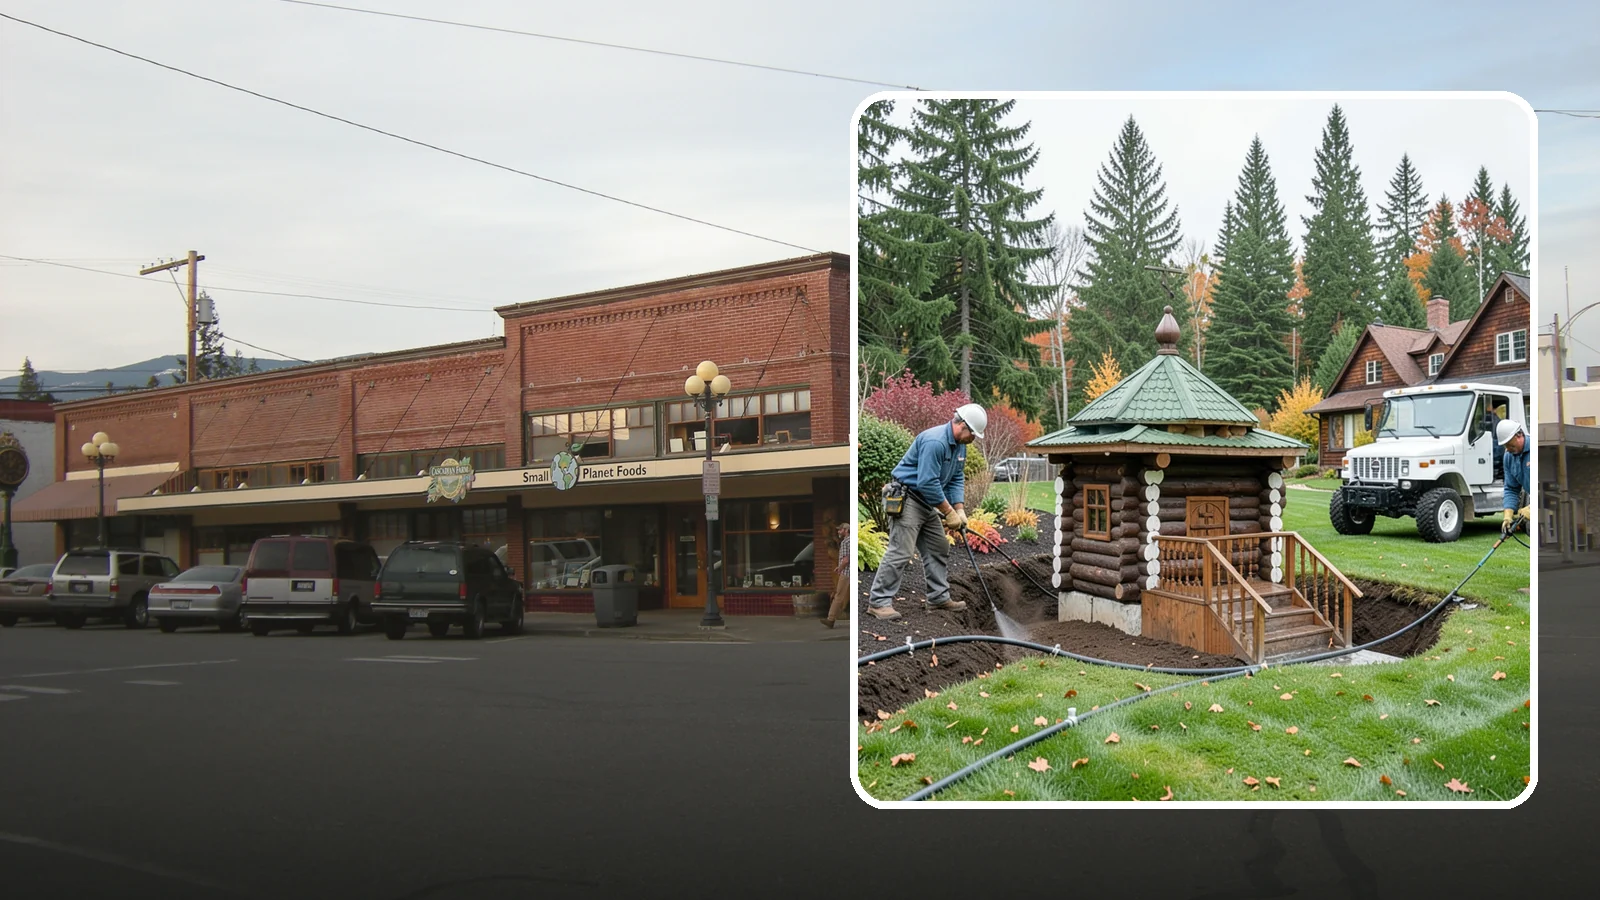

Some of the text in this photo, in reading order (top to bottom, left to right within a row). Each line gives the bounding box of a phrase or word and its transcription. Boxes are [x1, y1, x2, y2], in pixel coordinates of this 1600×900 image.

[523, 464, 647, 483] Small Planet Foods
